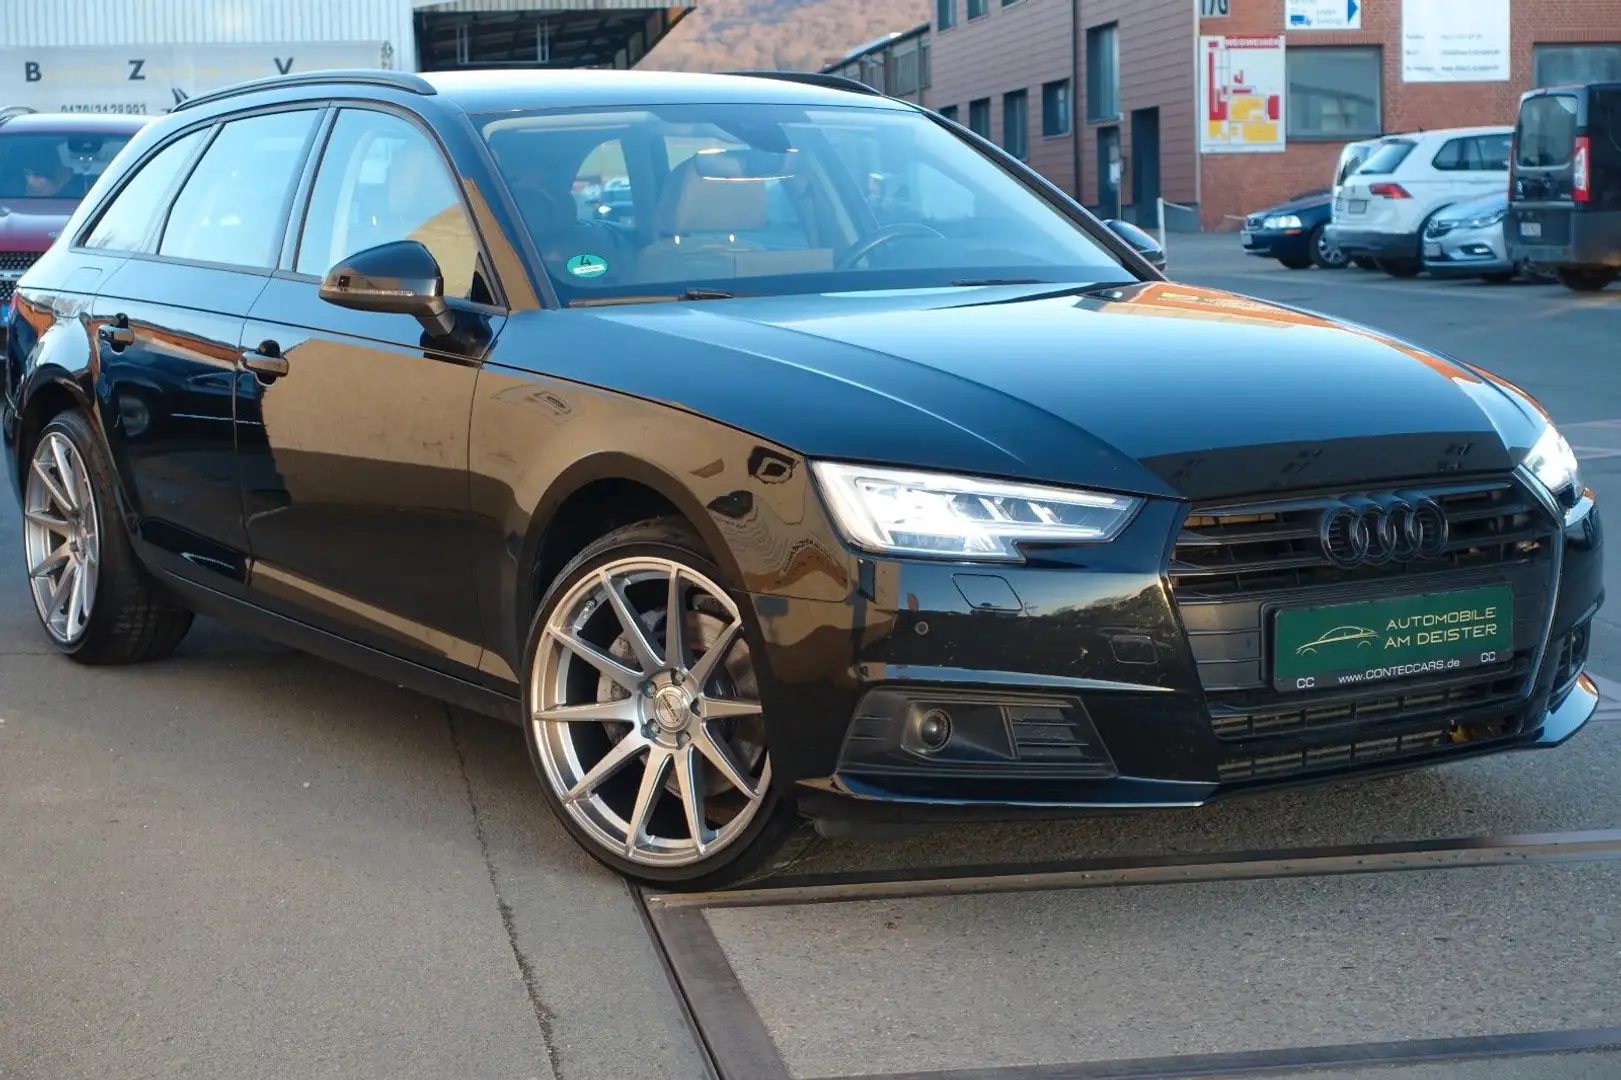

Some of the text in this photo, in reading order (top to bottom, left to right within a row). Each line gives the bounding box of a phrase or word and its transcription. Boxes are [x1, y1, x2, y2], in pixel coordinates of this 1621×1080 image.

[25, 62, 42, 82] B
[128, 60, 146, 80] Z
[580, 255, 591, 266] 4
[1385, 606, 1497, 631] AUTOMOBILE
[1384, 623, 1498, 650] AM DEISTER
[1296, 651, 1496, 689] CC www.CONTECCARS.de CC
